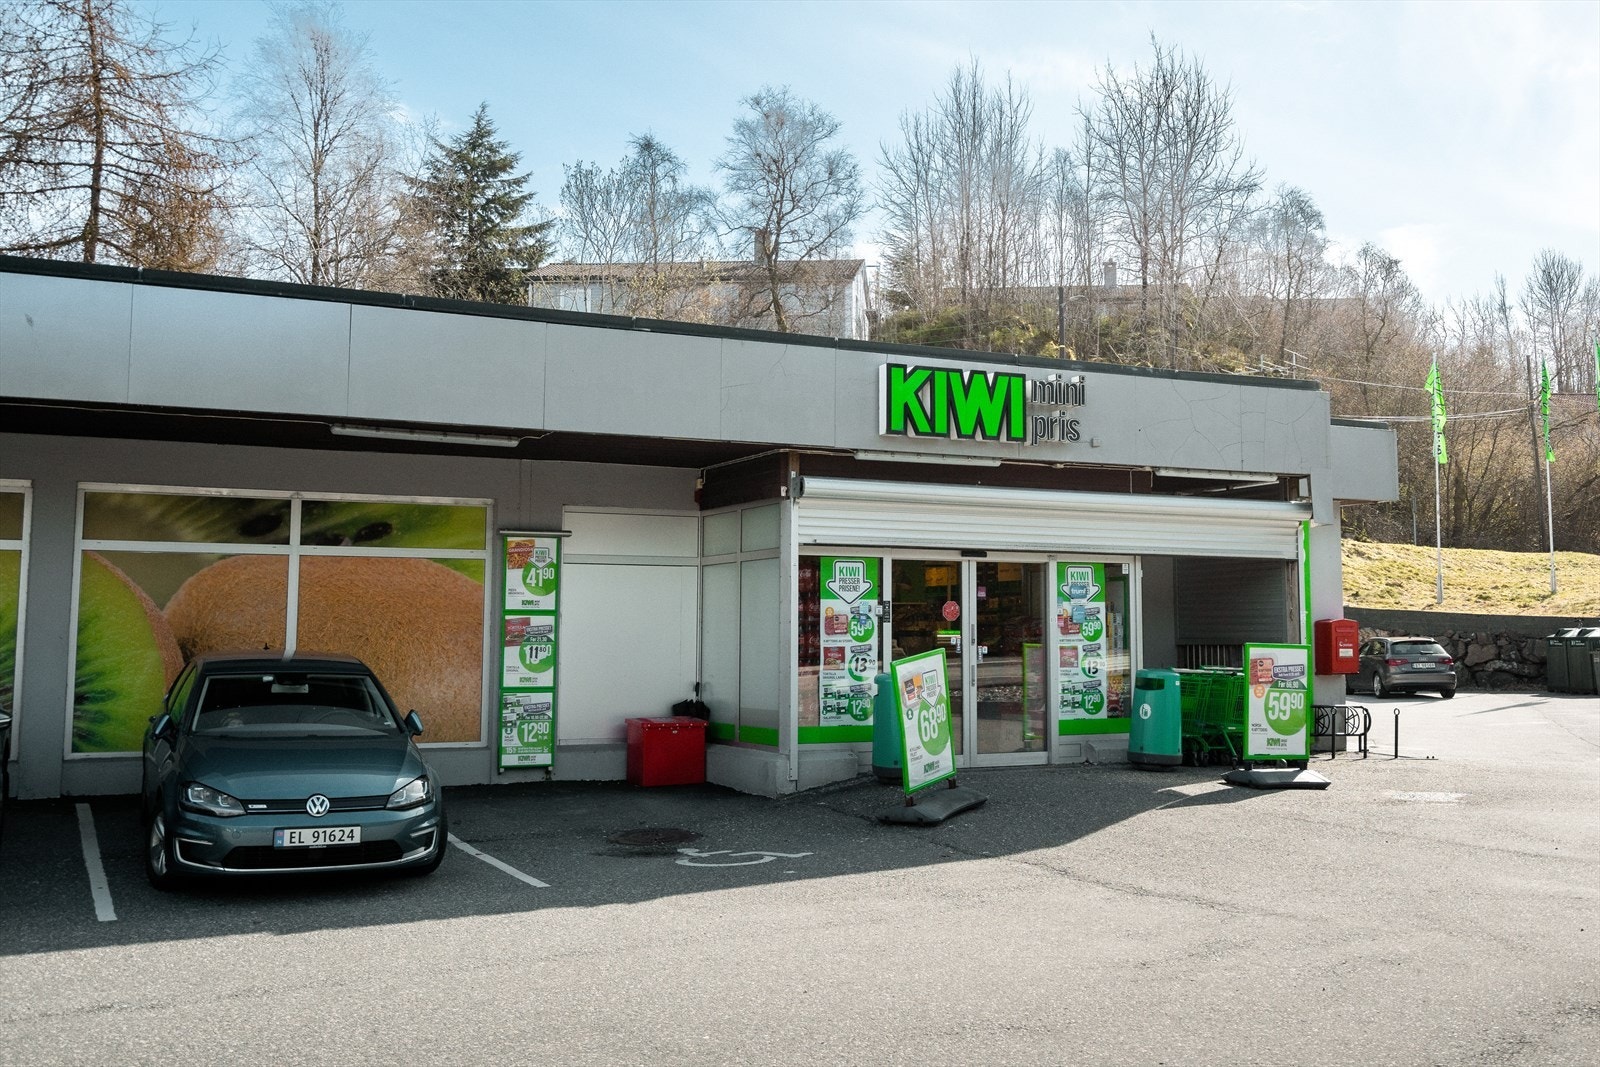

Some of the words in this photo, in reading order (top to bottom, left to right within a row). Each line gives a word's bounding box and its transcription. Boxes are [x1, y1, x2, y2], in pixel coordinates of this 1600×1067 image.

[1031, 373, 1086, 406] mini
[886, 362, 1026, 442] KIWI
[1031, 410, 1081, 446] pris
[839, 566, 860, 577] KIWI
[839, 577, 860, 585] PRESSER
[1070, 571, 1089, 581] KIWI
[838, 585, 860, 593] PRISENE!
[1268, 691, 1305, 721] 5990
[920, 703, 947, 743] 6890
[289, 831, 305, 845] EL
[312, 828, 355, 843] 91624
